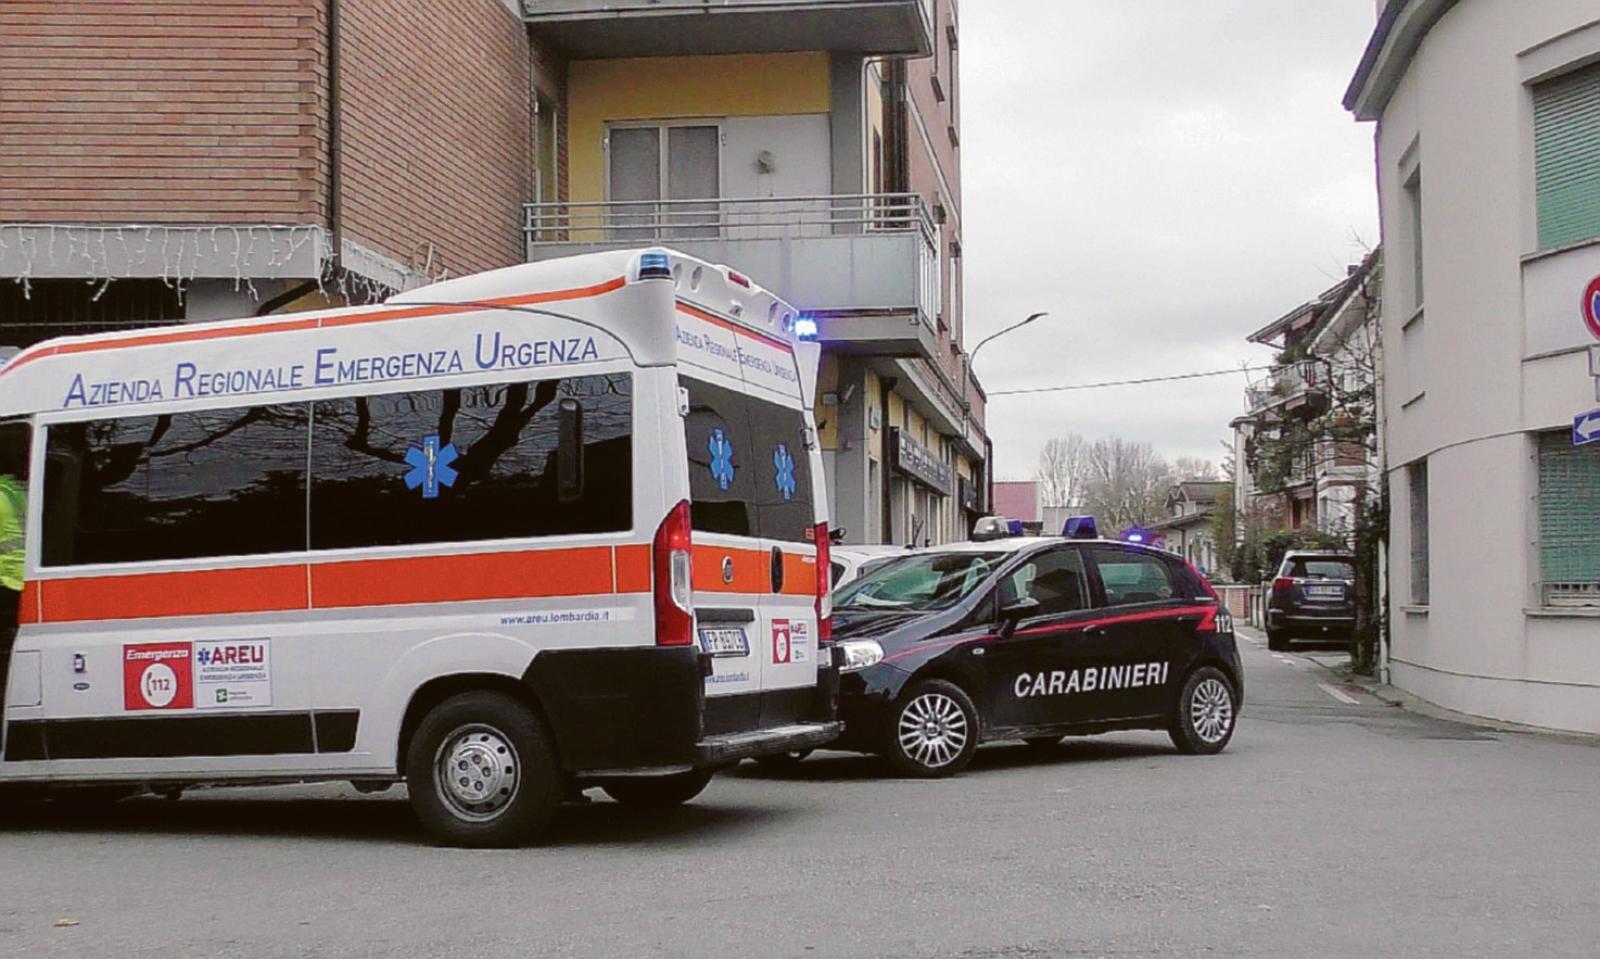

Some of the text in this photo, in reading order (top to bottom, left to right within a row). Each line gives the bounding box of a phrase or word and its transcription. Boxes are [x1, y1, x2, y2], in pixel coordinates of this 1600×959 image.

[63, 331, 599, 408] AZIENDA REGIONALE EMERGENZA URGENZA
[1214, 614, 1233, 633] 112
[210, 644, 264, 665] AREU
[151, 678, 170, 691] 112
[1014, 661, 1170, 697] CARABINIERI
